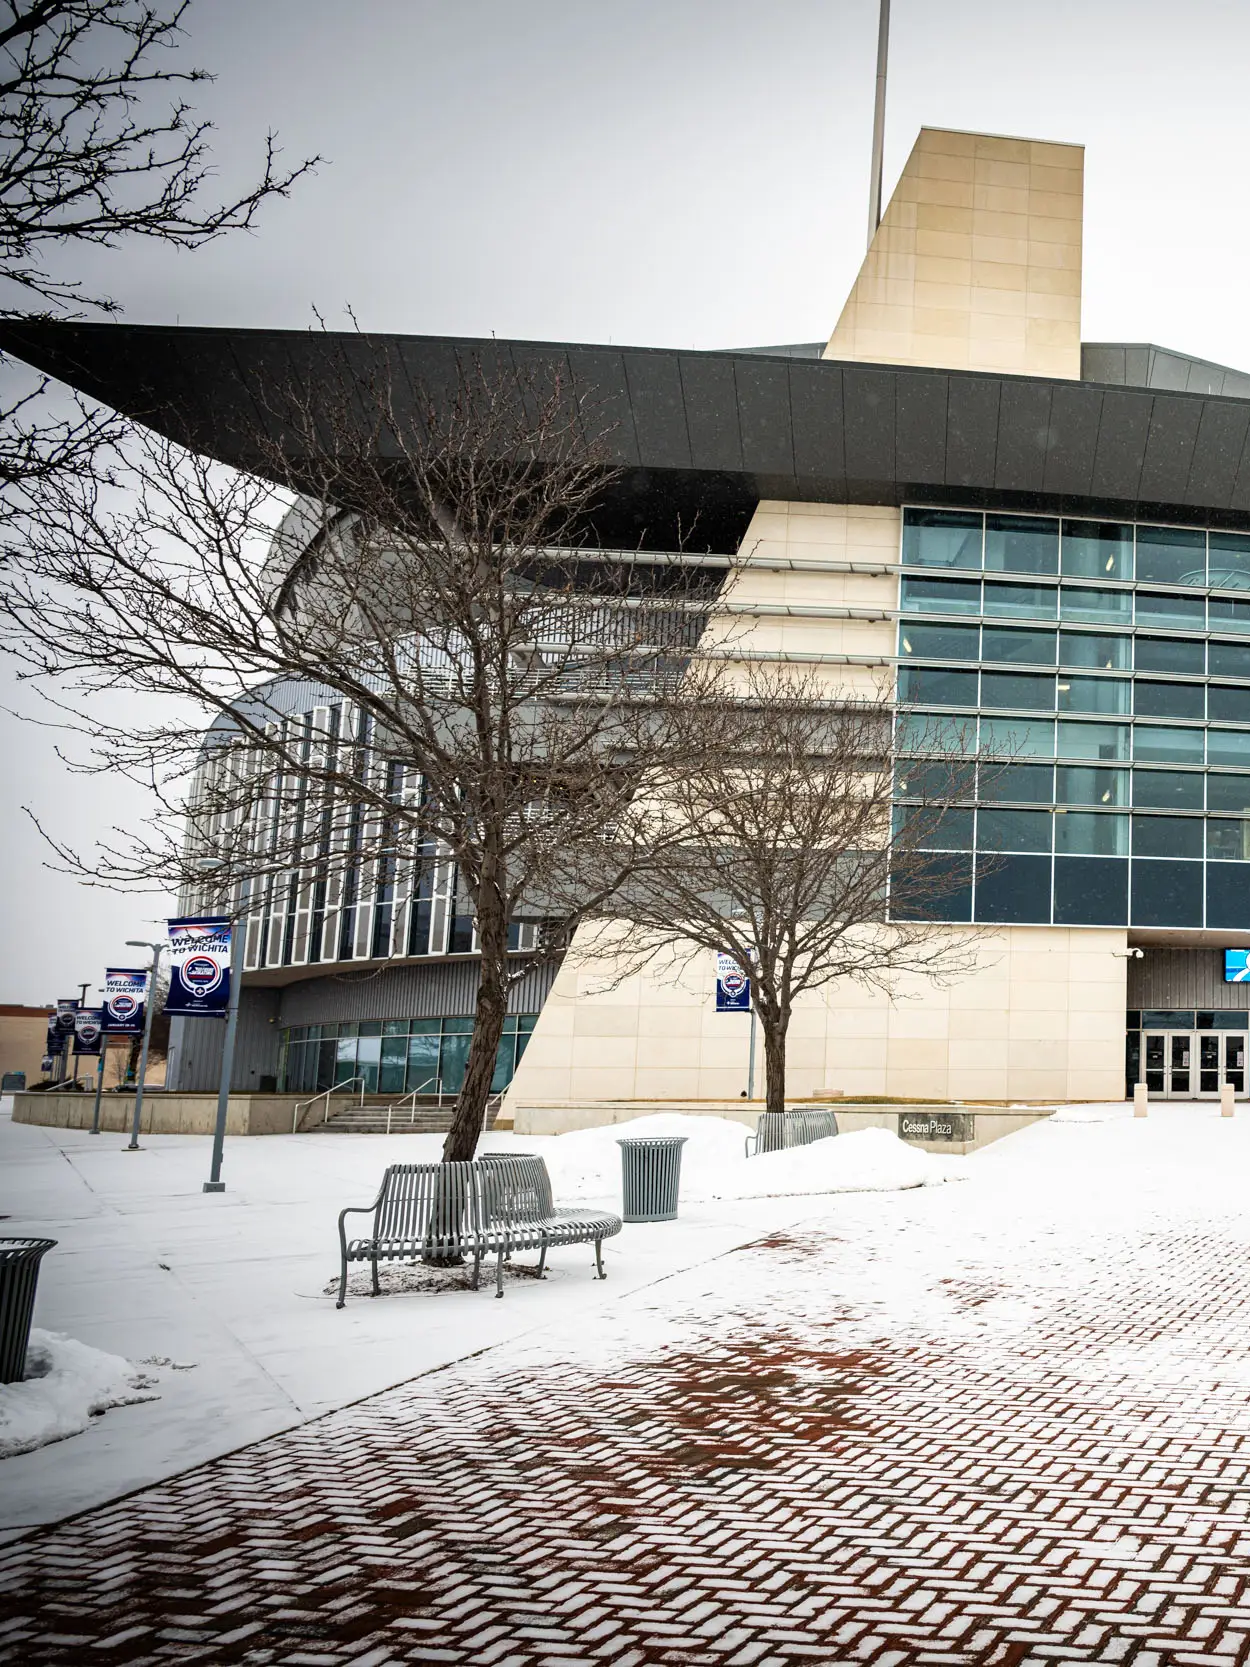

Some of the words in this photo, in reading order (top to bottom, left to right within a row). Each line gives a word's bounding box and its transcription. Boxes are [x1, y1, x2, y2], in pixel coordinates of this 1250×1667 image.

[172, 934, 229, 947] WELCOME
[187, 944, 229, 953] WICHITA
[902, 1119, 929, 1133] Cessna
[930, 1120, 952, 1134] Plaza
